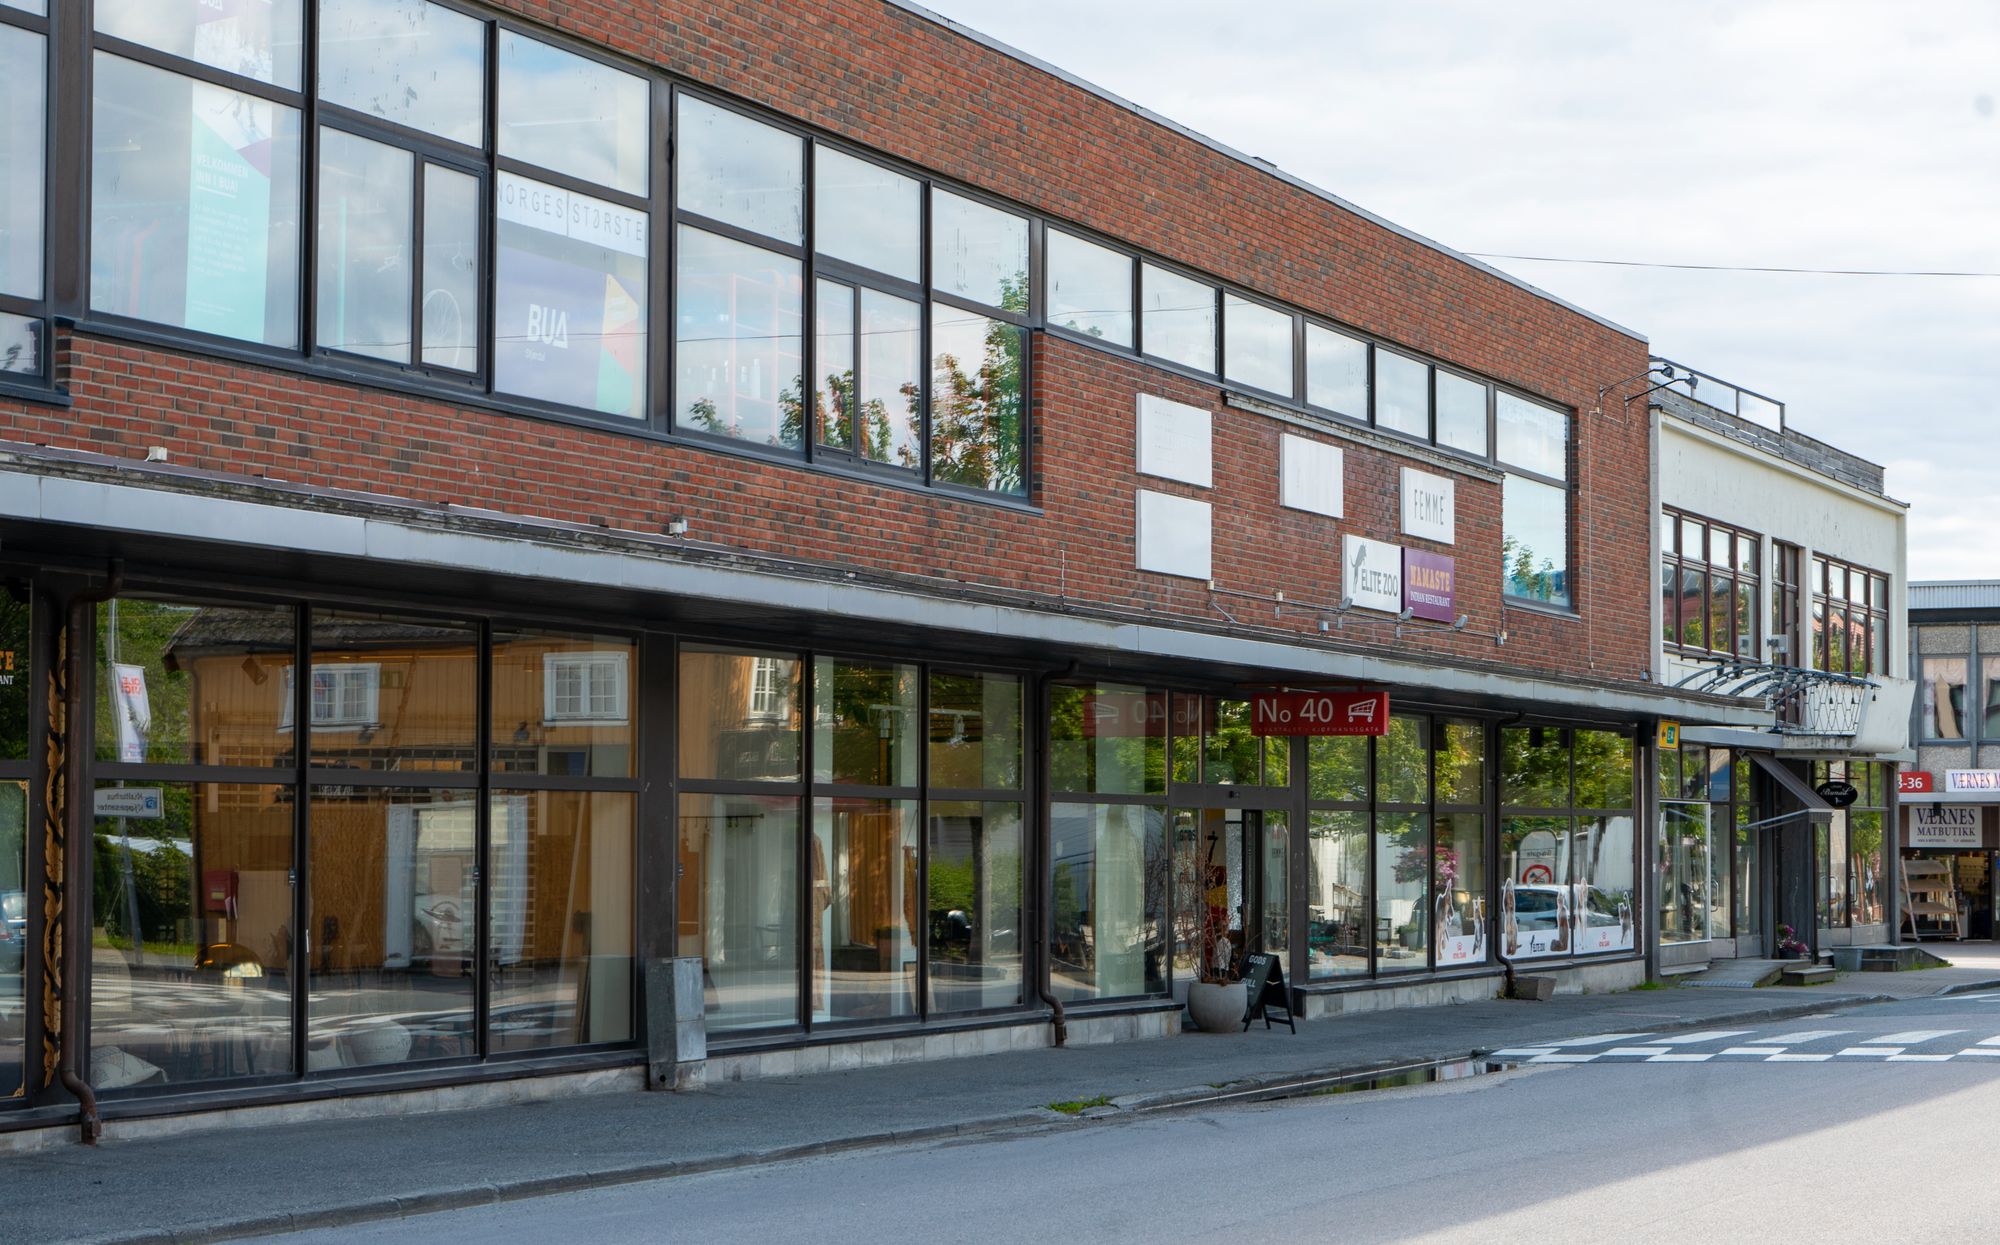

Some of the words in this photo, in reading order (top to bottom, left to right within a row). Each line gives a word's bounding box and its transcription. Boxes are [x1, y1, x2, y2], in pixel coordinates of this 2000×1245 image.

[527, 304, 569, 349] BUA
[1414, 489, 1444, 526] FEMME
[1361, 568, 1382, 594] ELITE
[1383, 573, 1399, 598] ZOO
[1410, 565, 1450, 593] NAMASTE
[1259, 698, 1291, 723] No
[1300, 698, 1333, 723] 40
[1951, 772, 1991, 789] VÆRNES
[1916, 807, 1976, 825] VÆRNES
[1916, 826, 1976, 837] MATBUTIKK
